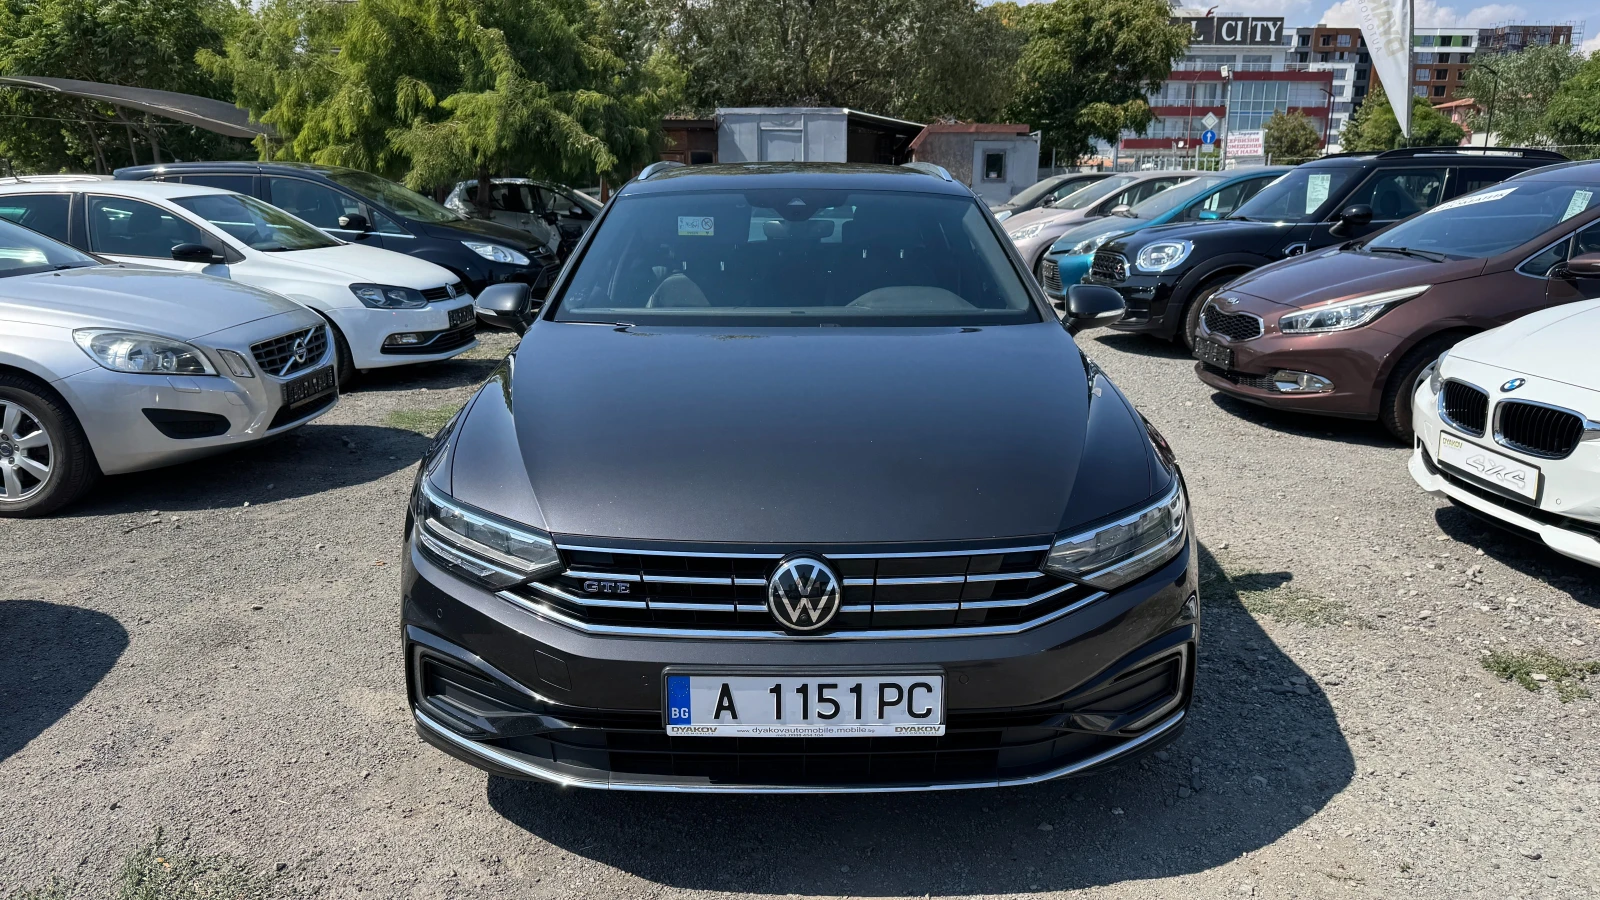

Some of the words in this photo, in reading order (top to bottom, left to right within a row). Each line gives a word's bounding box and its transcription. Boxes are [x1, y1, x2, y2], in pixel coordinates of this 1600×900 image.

[1221, 21, 1281, 41] CITY
[584, 581, 630, 593] GTE
[713, 683, 738, 719] A
[671, 708, 689, 719] BG
